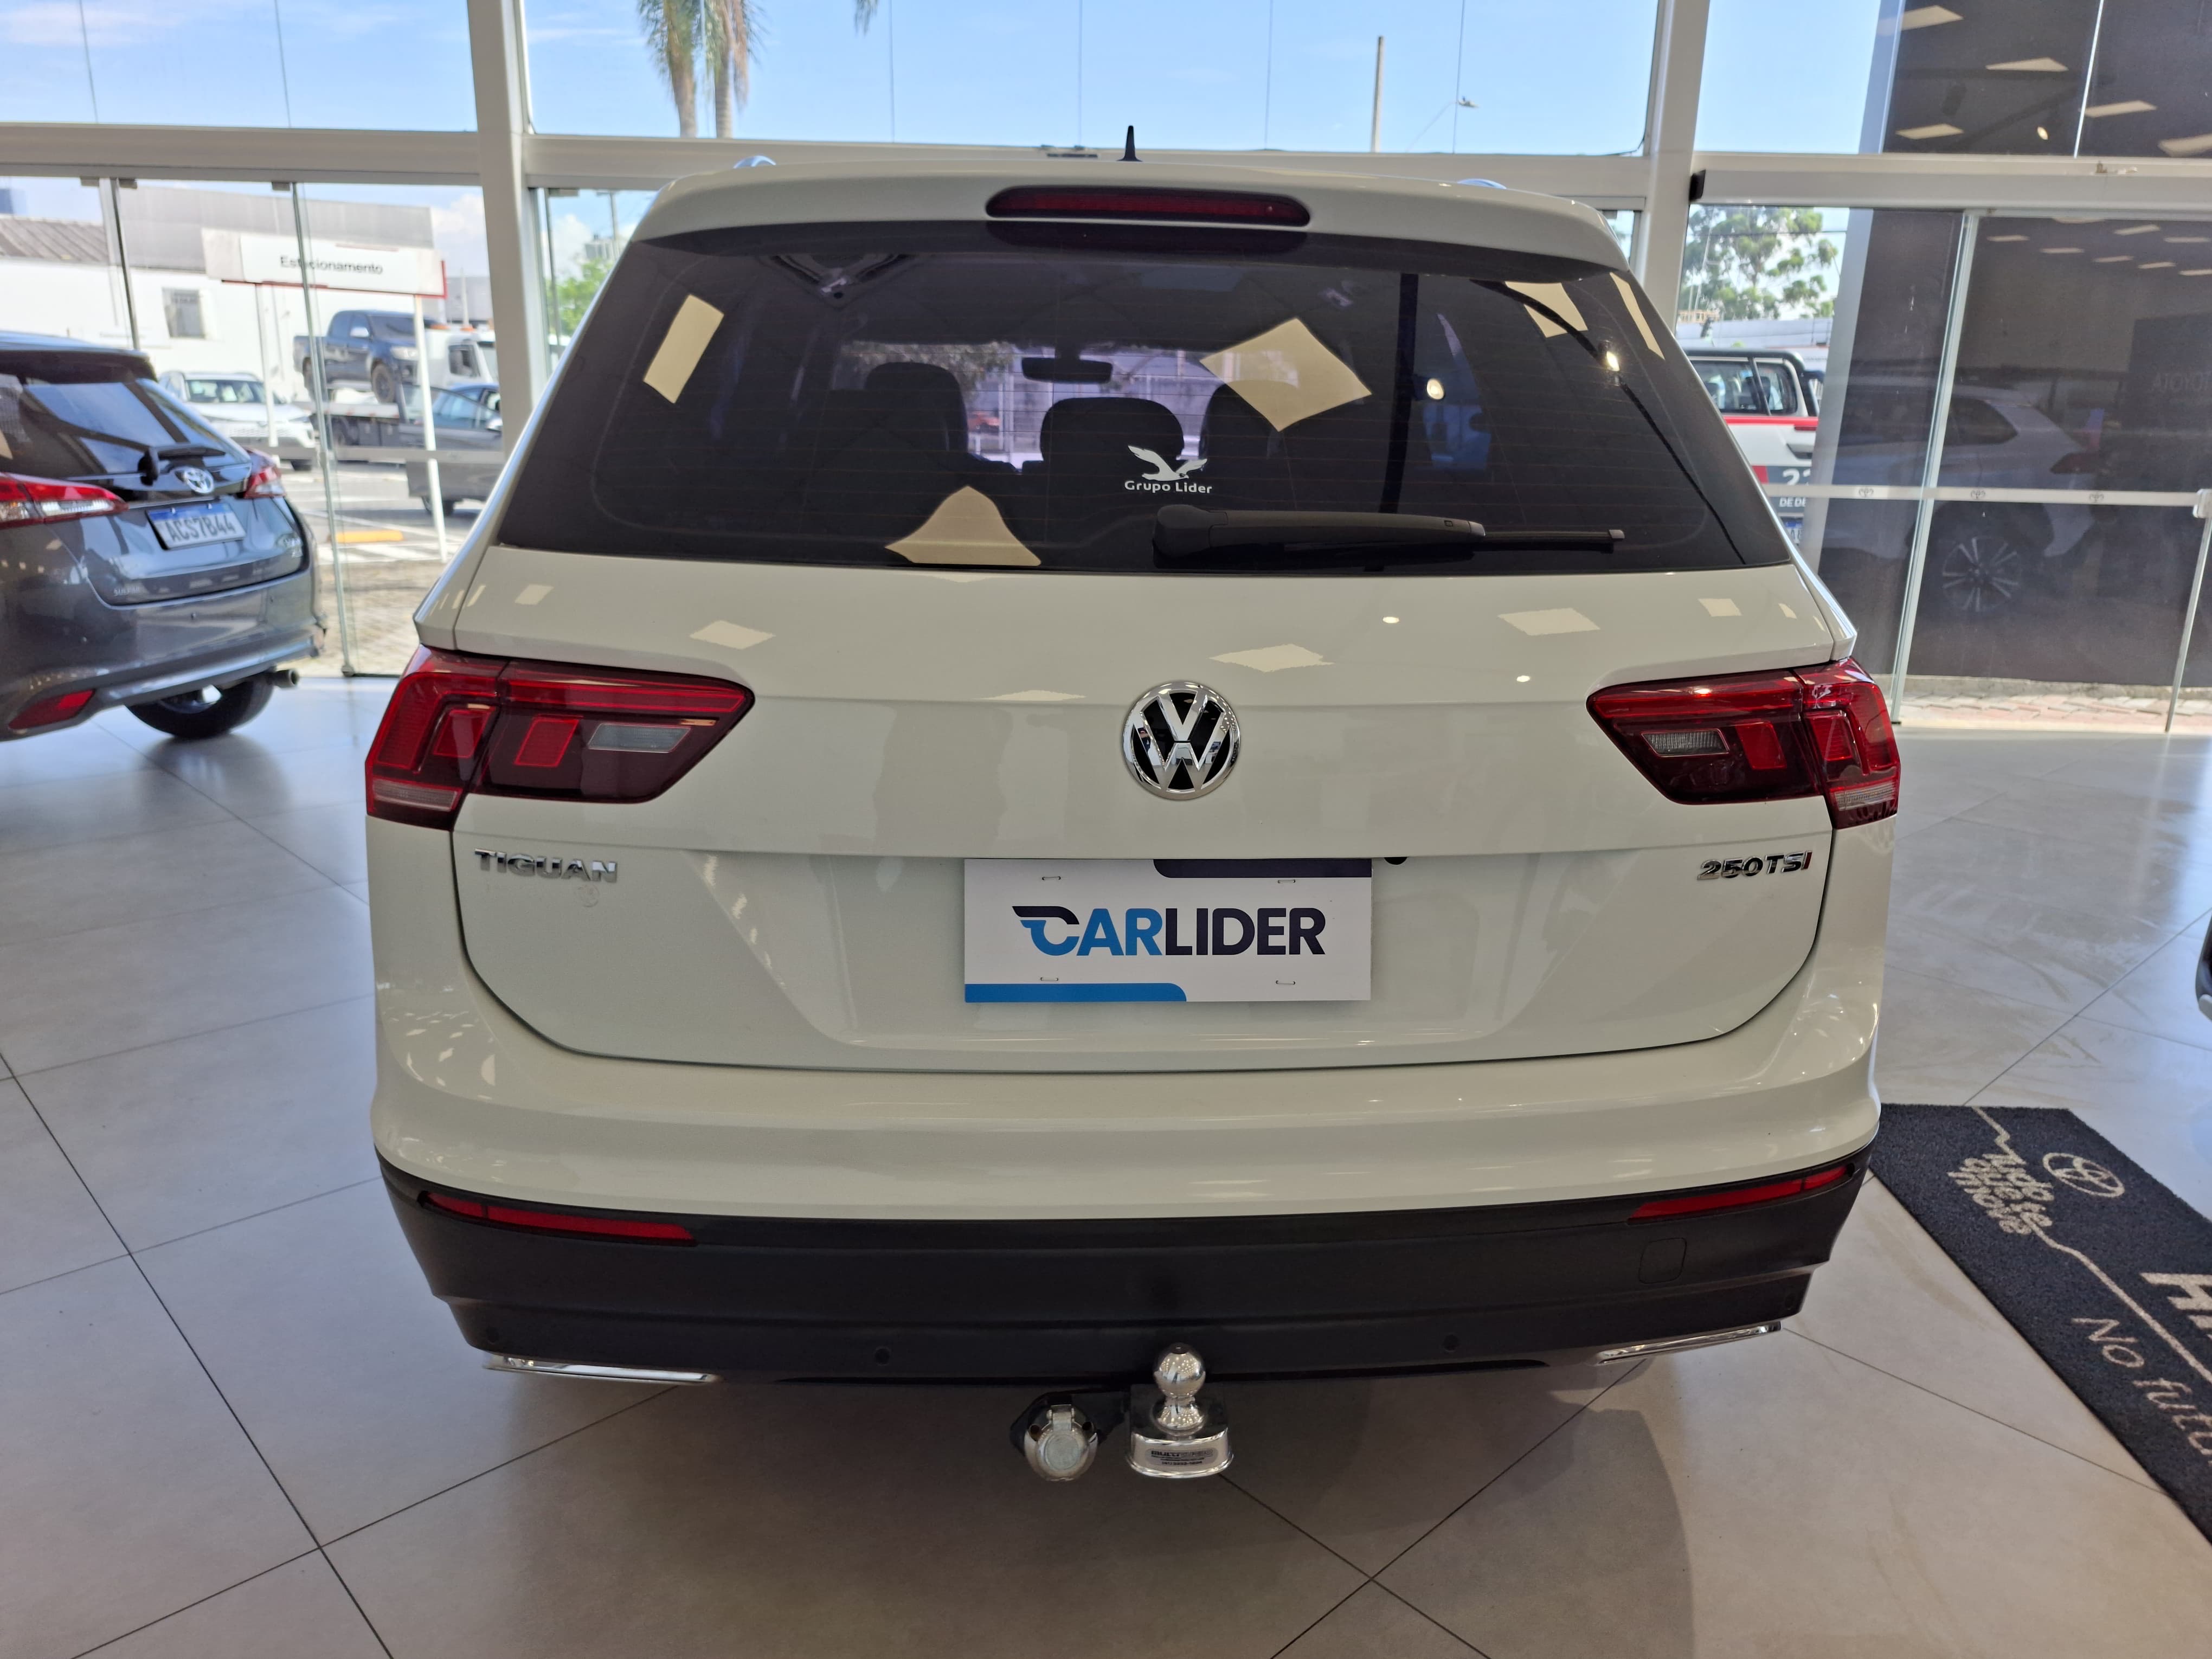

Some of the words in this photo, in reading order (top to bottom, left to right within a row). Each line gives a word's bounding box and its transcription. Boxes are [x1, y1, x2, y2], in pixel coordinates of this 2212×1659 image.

[1124, 480, 1171, 493] Grupo
[1175, 482, 1213, 493] Lider
[165, 515, 237, 542] ACS7B44
[474, 848, 616, 883] TIGUAN
[1007, 905, 1327, 956] CARLIDER
